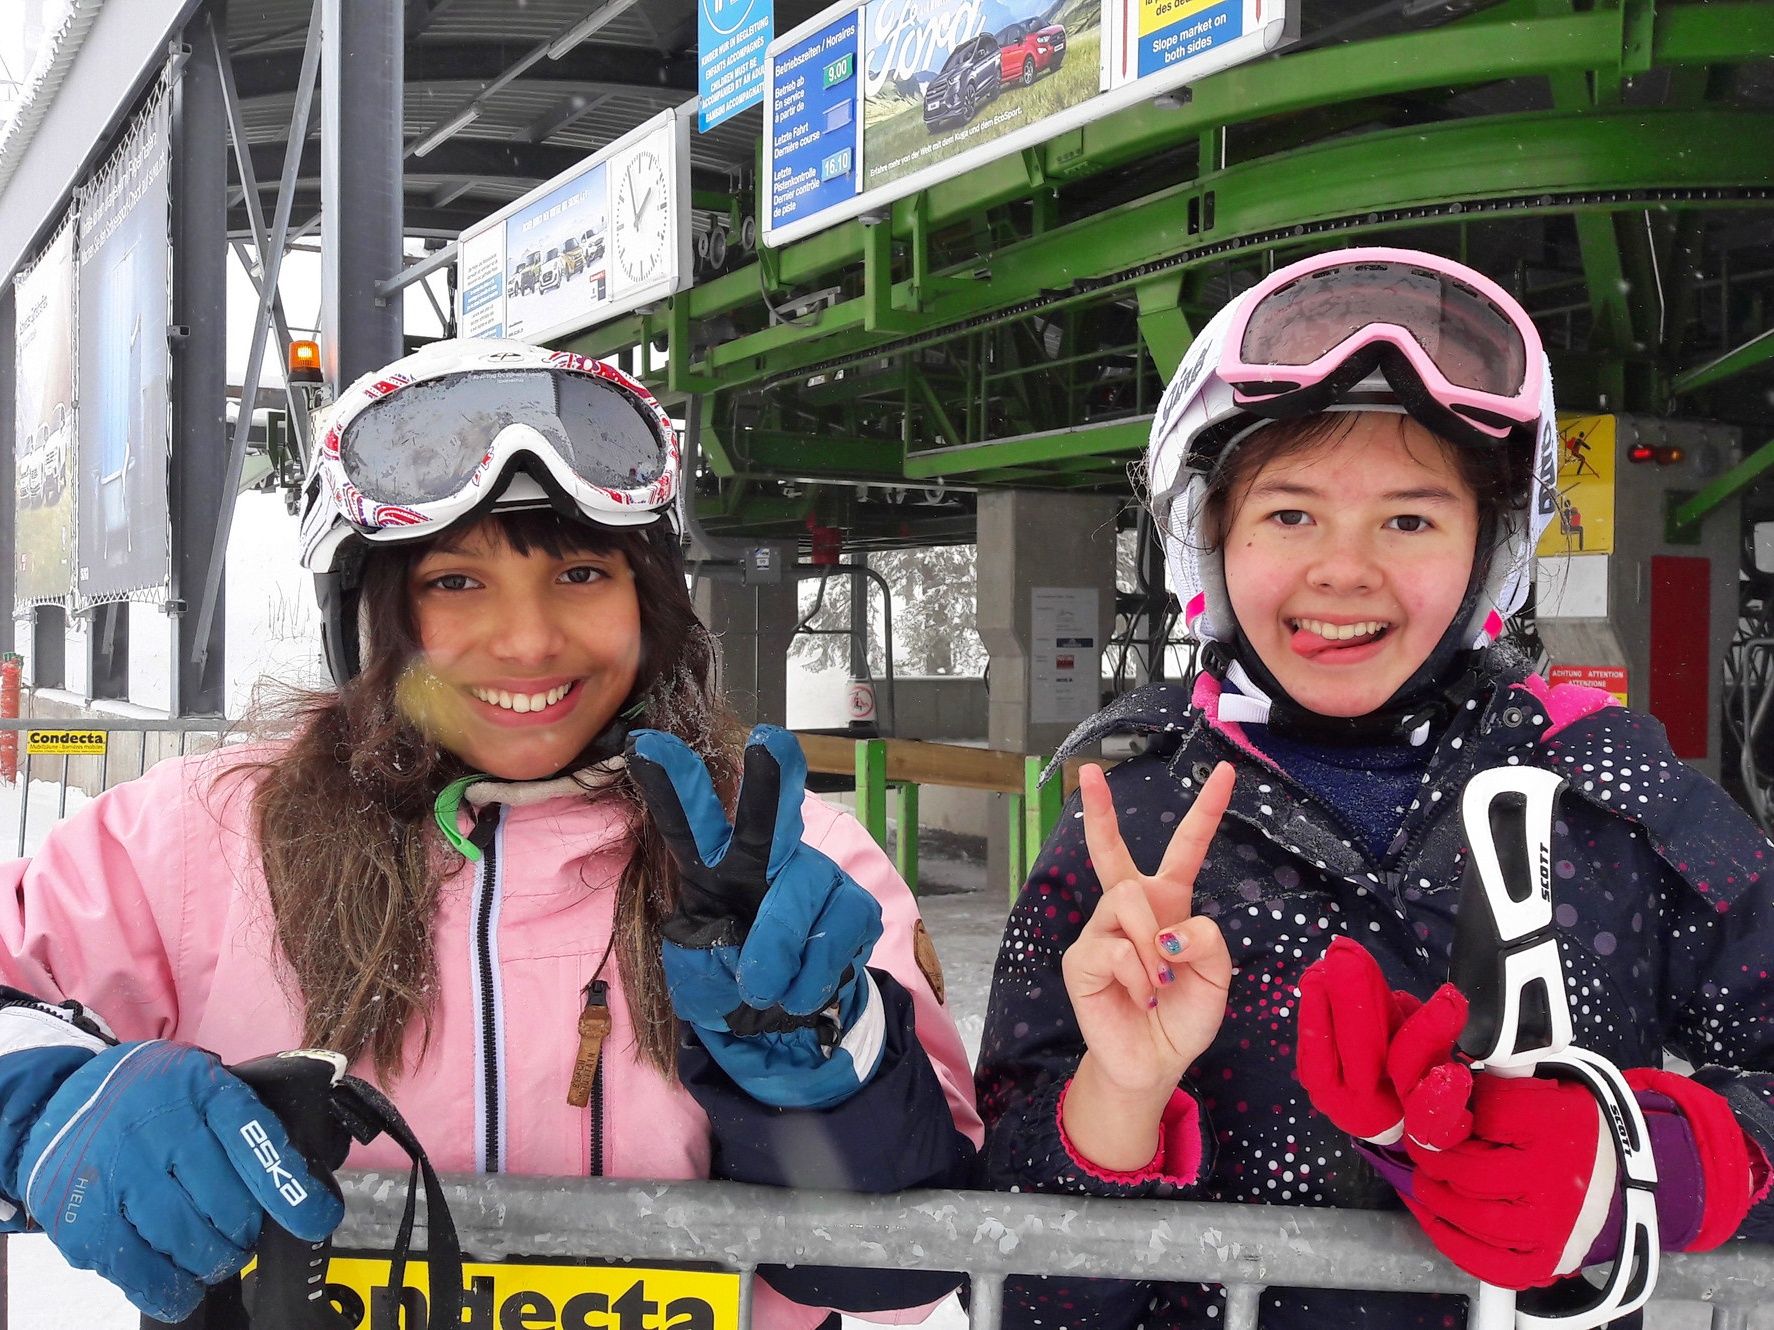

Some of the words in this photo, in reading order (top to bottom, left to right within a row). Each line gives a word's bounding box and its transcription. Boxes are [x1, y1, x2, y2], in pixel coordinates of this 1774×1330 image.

[1156, 2, 1171, 16] des
[1152, 34, 1177, 53] Slope
[1179, 17, 1213, 41] market
[1214, 13, 1227, 27] on
[775, 44, 820, 77] Betriebszeiten
[826, 25, 855, 48] Horaires
[1164, 46, 1185, 63] both
[1187, 35, 1212, 54] sides
[735, 61, 749, 78] MUST
[828, 59, 847, 82] 9.00
[774, 79, 796, 99] Betrieb
[796, 75, 804, 86] ab
[774, 100, 783, 112] En
[784, 89, 804, 108] service
[780, 104, 796, 124] partir
[796, 101, 804, 112] de
[774, 132, 792, 148] Letzte
[792, 122, 809, 138] Fahrt
[774, 140, 799, 160] Dernière
[800, 130, 820, 147] course
[870, 164, 888, 177] Erfahre
[888, 158, 900, 170] mehr
[901, 154, 910, 165] von
[920, 144, 932, 156] Welt
[969, 123, 980, 135] und
[980, 118, 993, 130] dem
[774, 166, 792, 181] Letzte
[824, 152, 848, 177] 16.10
[774, 167, 817, 194] Pistenkontrolle
[774, 188, 795, 206] Dernier
[773, 206, 781, 218] de
[782, 201, 796, 216] piste
[1588, 670, 1624, 678] ATTENTION
[30, 732, 103, 744] Condecta
[1541, 842, 1550, 902] SCOTT
[1609, 1104, 1632, 1158] SCOTT
